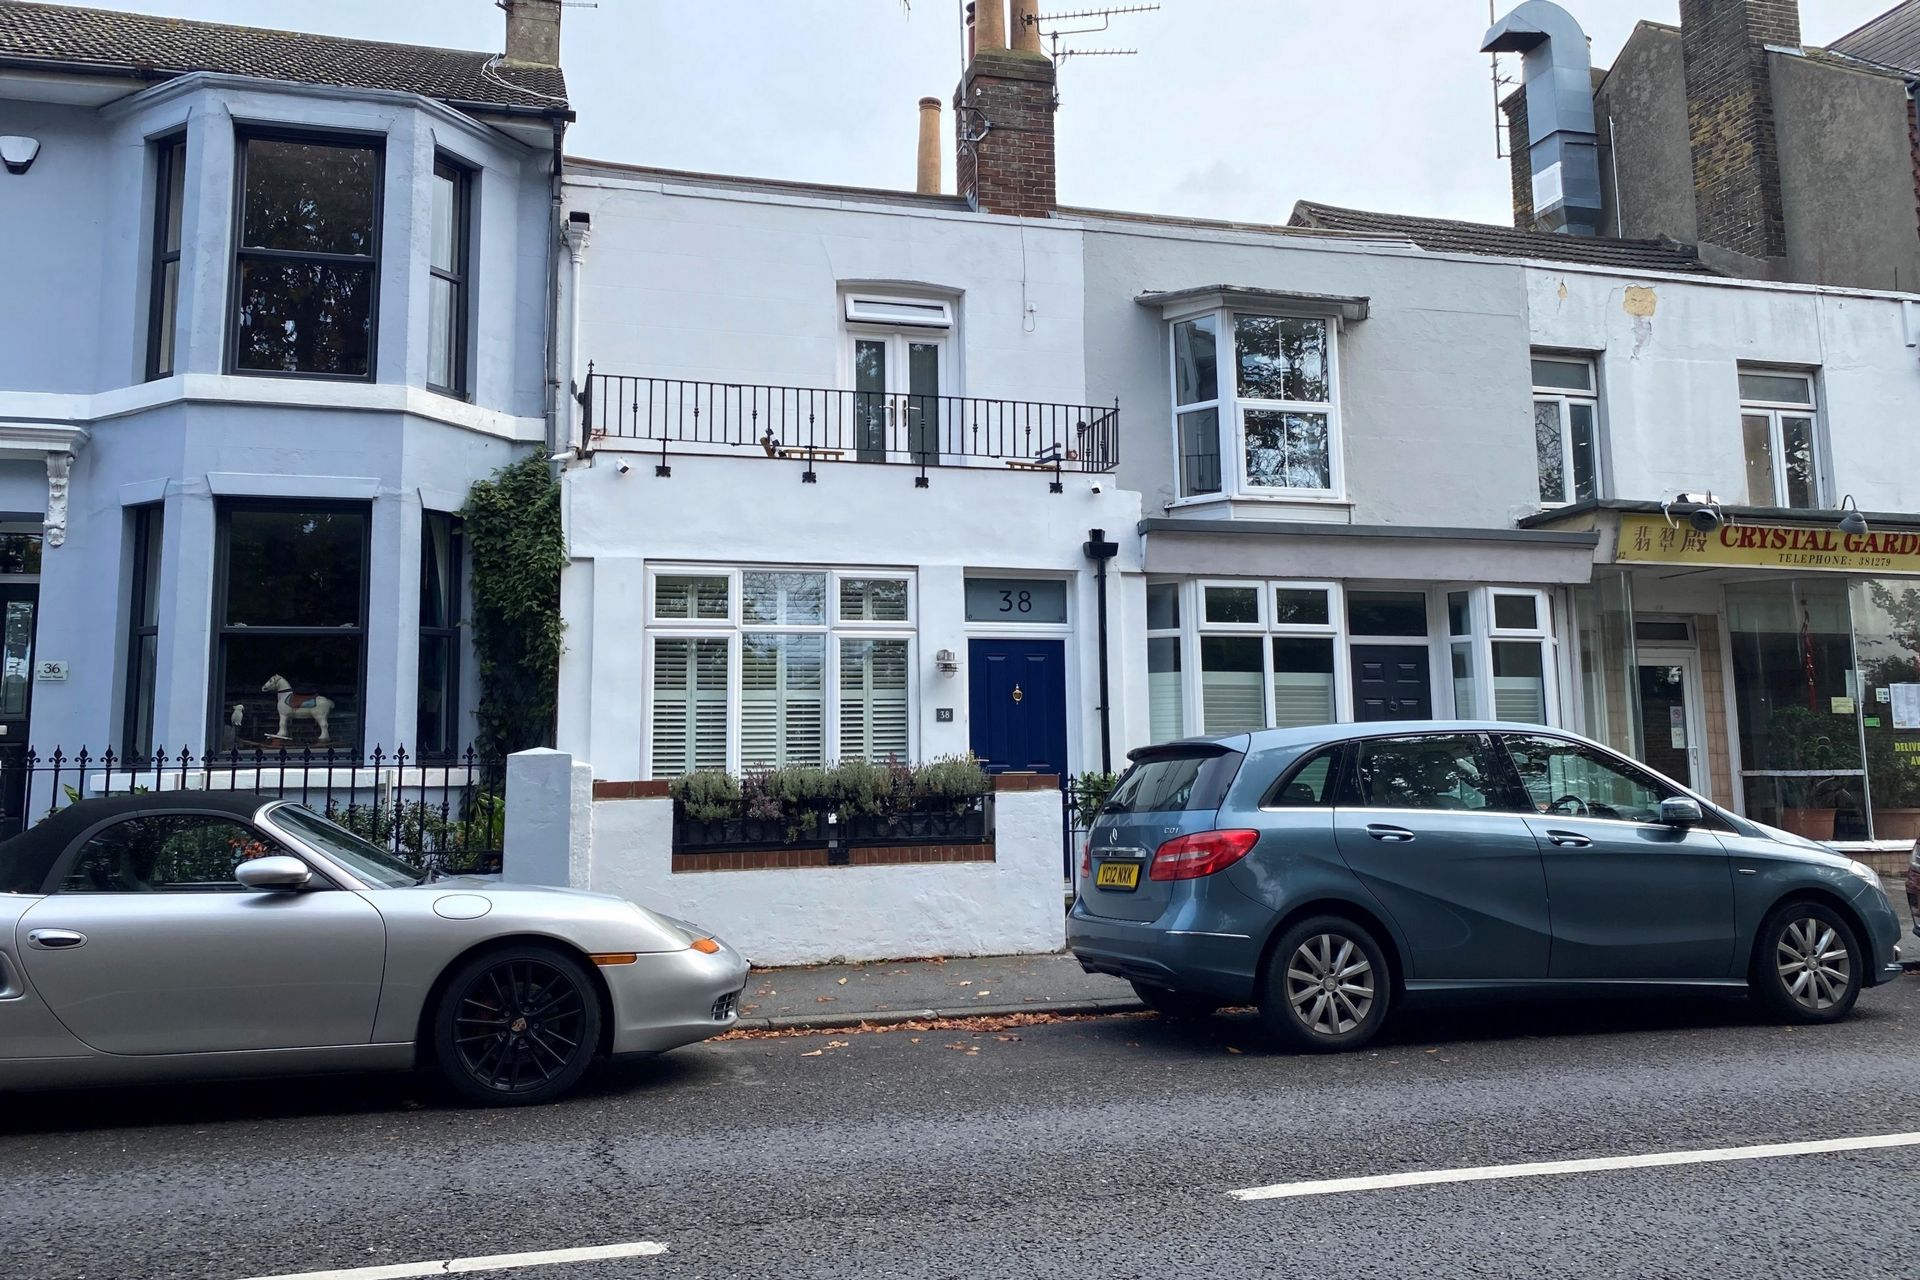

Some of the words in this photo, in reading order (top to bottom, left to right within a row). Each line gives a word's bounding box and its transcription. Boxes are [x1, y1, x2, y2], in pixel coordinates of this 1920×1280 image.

[1720, 525, 1838, 552] CRYSTAL
[1779, 552, 1852, 566] TELEPHONE:
[1858, 556, 1891, 567] 381279
[999, 590, 1032, 613] 38
[44, 663, 60, 674] 36
[940, 710, 950, 719] 38
[1118, 867, 1134, 884] NXK
